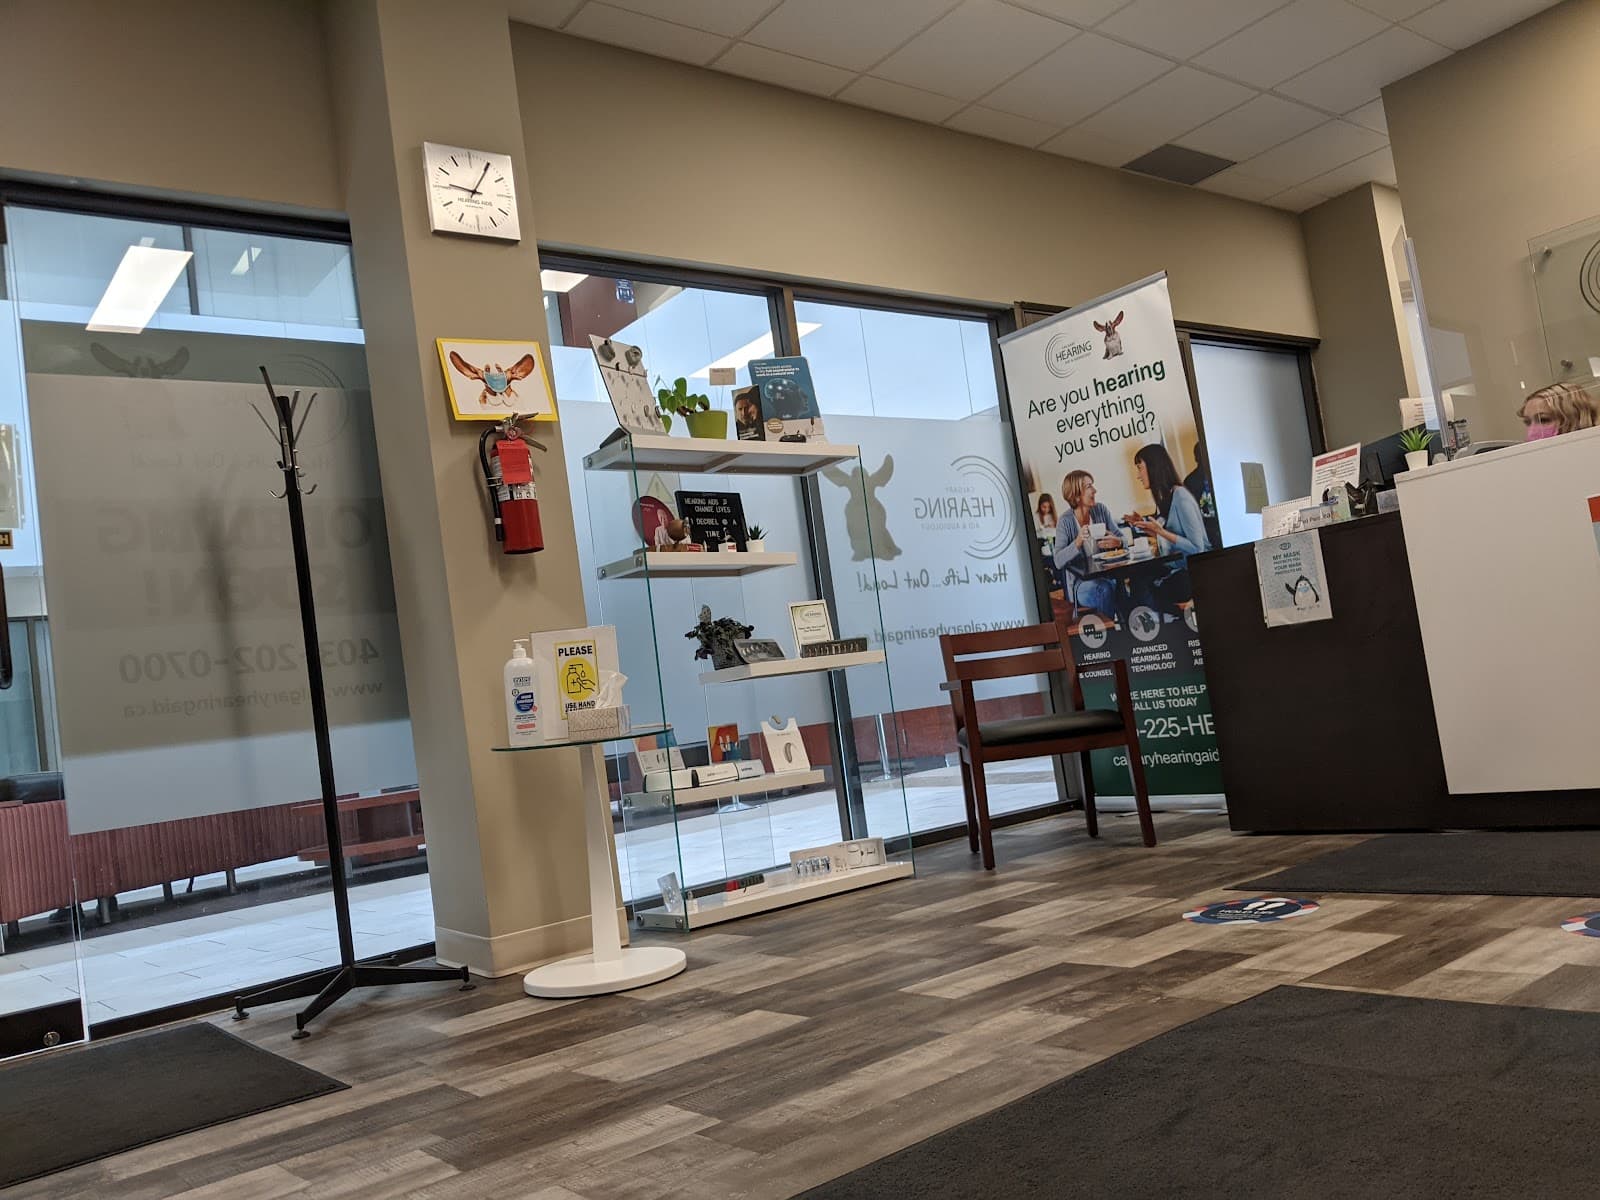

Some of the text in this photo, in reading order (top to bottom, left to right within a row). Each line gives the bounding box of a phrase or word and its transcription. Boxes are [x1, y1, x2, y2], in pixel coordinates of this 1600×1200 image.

[1055, 340, 1092, 362] HEARING
[1028, 360, 1166, 418] Are you hearing
[1056, 392, 1146, 433] everything
[1054, 411, 1156, 463] you should?
[696, 518, 719, 526] DECIBEL
[705, 530, 720, 538] TIME
[1132, 643, 1168, 654] ADVANCED
[1187, 639, 1201, 648] RIS
[558, 645, 593, 657] PLEASE
[1083, 651, 1111, 661] HEARING
[1192, 648, 1203, 656] HE
[1130, 652, 1173, 664] HEARING AID
[1130, 661, 1176, 673] TECHNOLOGY
[1140, 688, 1166, 699] HERE
[1166, 686, 1180, 696] TO
[1181, 684, 1207, 695] HELP
[578, 700, 596, 708] HAND
[1132, 697, 1198, 711] ALL US TODAY
[1136, 713, 1216, 739] -225-HE
[1113, 748, 1219, 767] caryhearingaid
